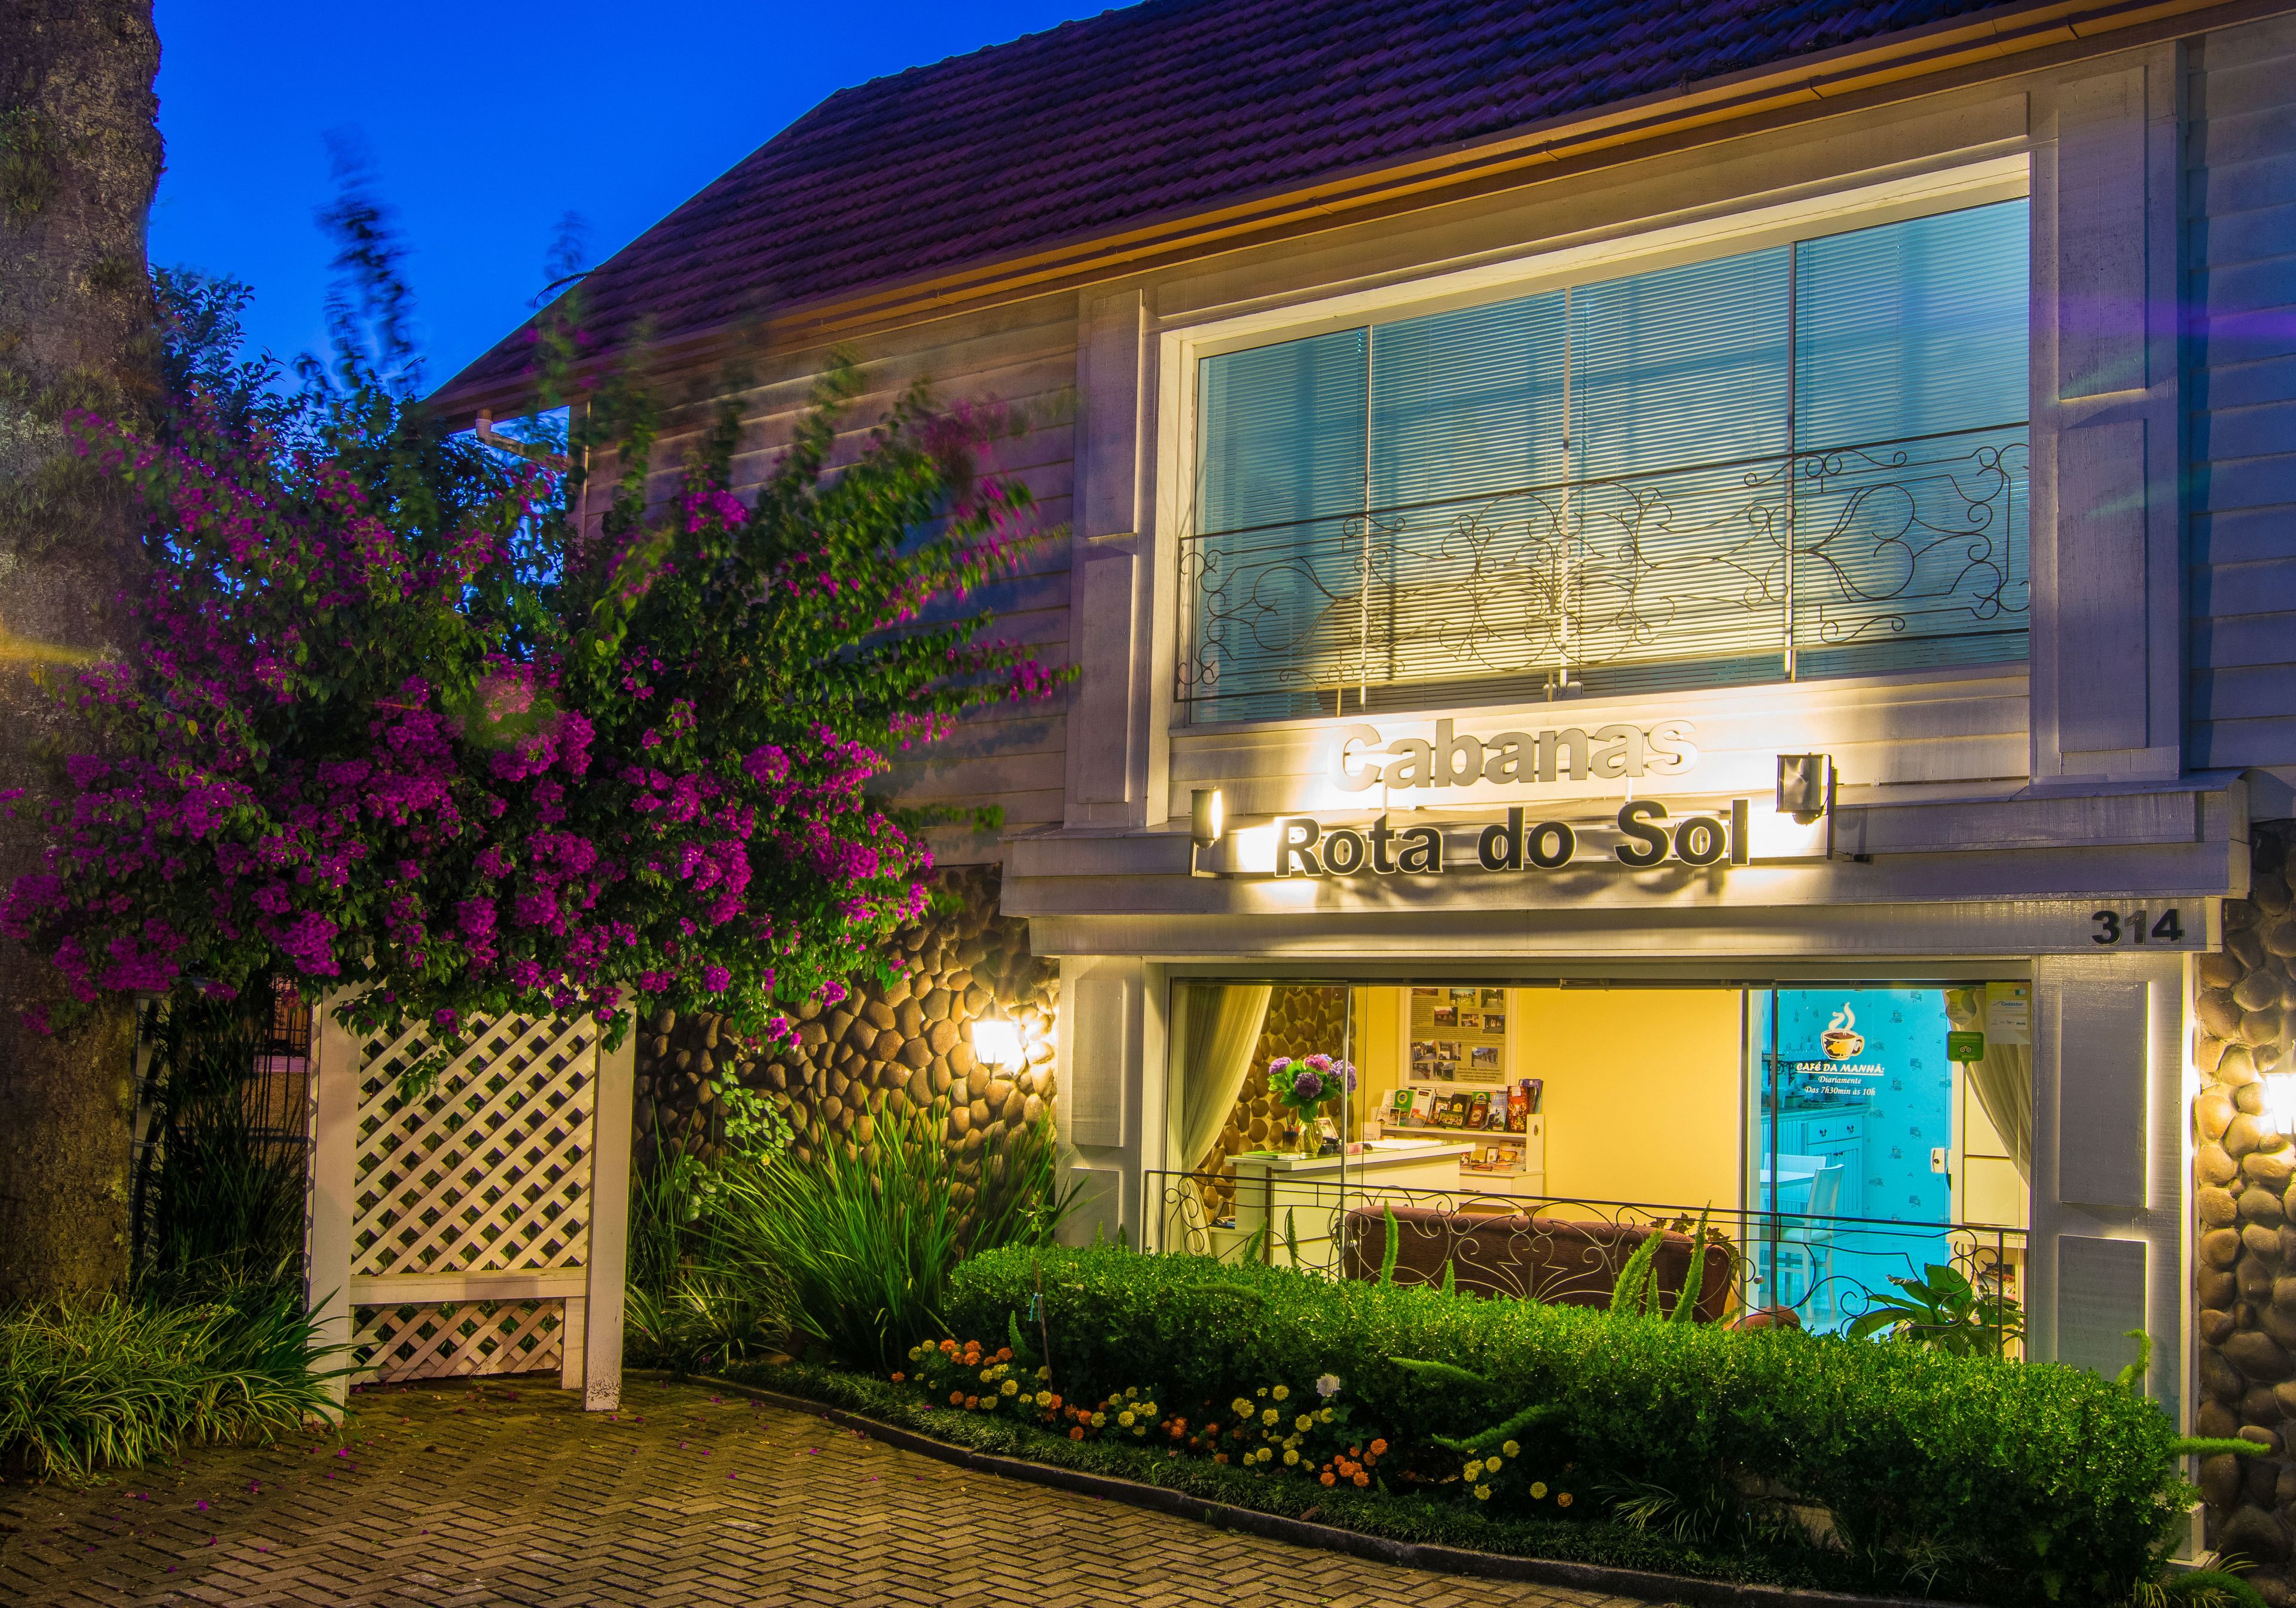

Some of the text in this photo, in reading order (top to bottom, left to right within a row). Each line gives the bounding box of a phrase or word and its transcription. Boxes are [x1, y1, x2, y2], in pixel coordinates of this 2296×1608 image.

[1327, 718, 1699, 792] Cabanas
[1274, 798, 1751, 877] Rota do Sol
[2092, 908, 2185, 945] 314
[1796, 1061, 1821, 1071] CAFÉ
[1823, 1063, 1837, 1072] DA
[1818, 1076, 1862, 1084] Diariamente
[1821, 1086, 1851, 1094] 7h30min
[1863, 1087, 1876, 1096] 10h
